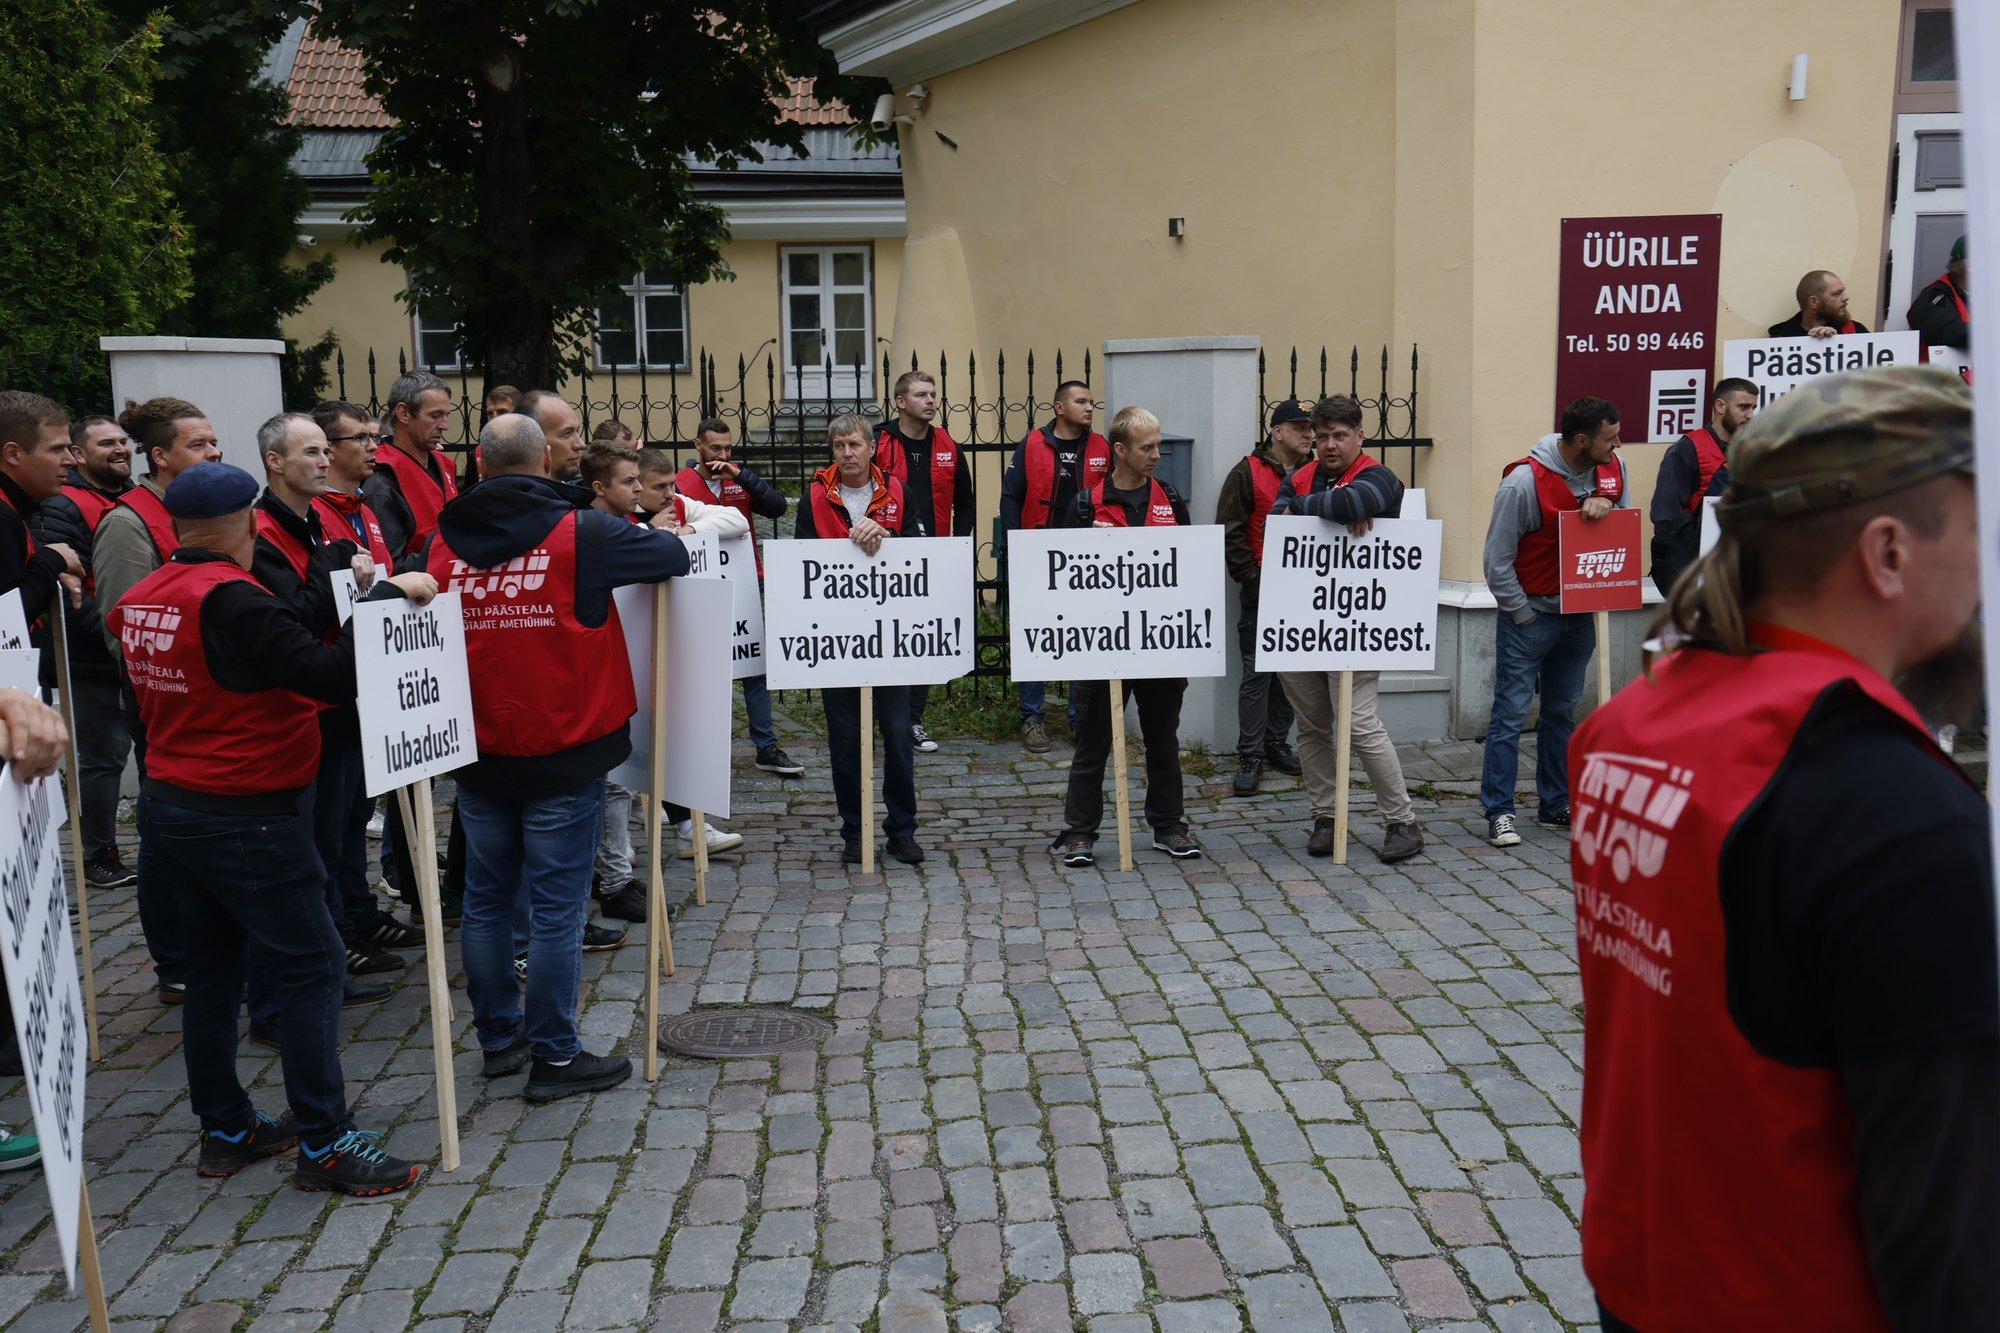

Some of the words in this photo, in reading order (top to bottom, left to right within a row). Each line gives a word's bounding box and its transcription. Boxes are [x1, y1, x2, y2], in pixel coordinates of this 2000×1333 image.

[1583, 231, 1699, 268] ÜÜRILE
[1594, 283, 1682, 315] ANDA
[1566, 335, 1599, 353] Tel.
[1606, 334, 1631, 352] 50
[1637, 333, 1661, 351] 99
[1667, 332, 1704, 350] 446
[1656, 408, 1696, 435] RE
[1047, 547, 1178, 596] Päästjaid
[1282, 535, 1422, 577] Riigikaitse
[802, 557, 929, 606] Päästjaid
[1313, 578, 1387, 619] algab
[484, 604, 554, 616] PÄÄSTEALA
[383, 610, 444, 655] Poliitik,
[779, 619, 883, 668] vajavad
[892, 617, 961, 658] kõik!
[1024, 611, 1130, 660] vajavad
[1140, 608, 1212, 650] kõik!
[1262, 619, 1431, 653] sisekaitsest.
[397, 667, 440, 711] täida
[385, 718, 460, 774] lubadus!!
